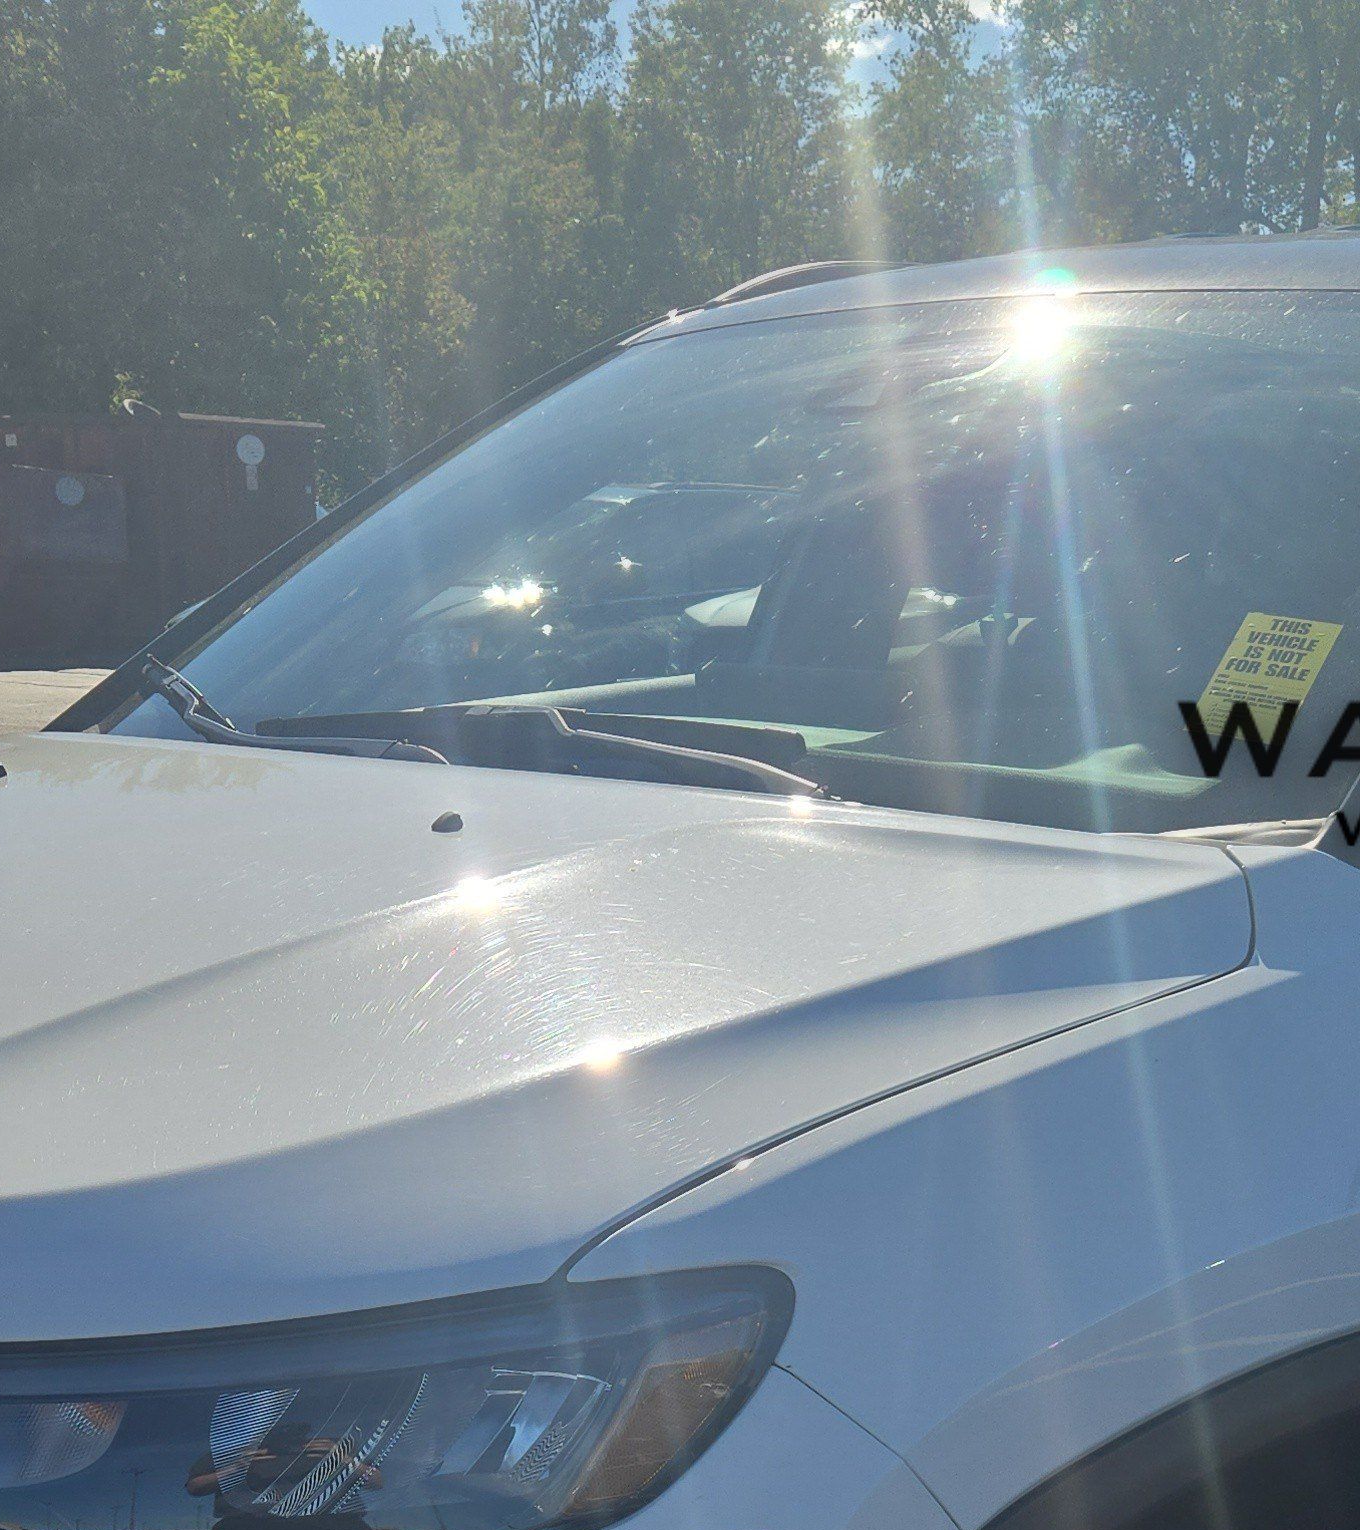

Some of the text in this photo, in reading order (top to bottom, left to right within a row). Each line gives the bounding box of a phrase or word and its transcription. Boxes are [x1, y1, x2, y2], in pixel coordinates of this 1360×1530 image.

[1271, 619, 1312, 635] THIS
[1247, 631, 1319, 651] VEHICLE
[1244, 645, 1307, 664] IS NOT
[1225, 658, 1310, 681] FOR SALE
